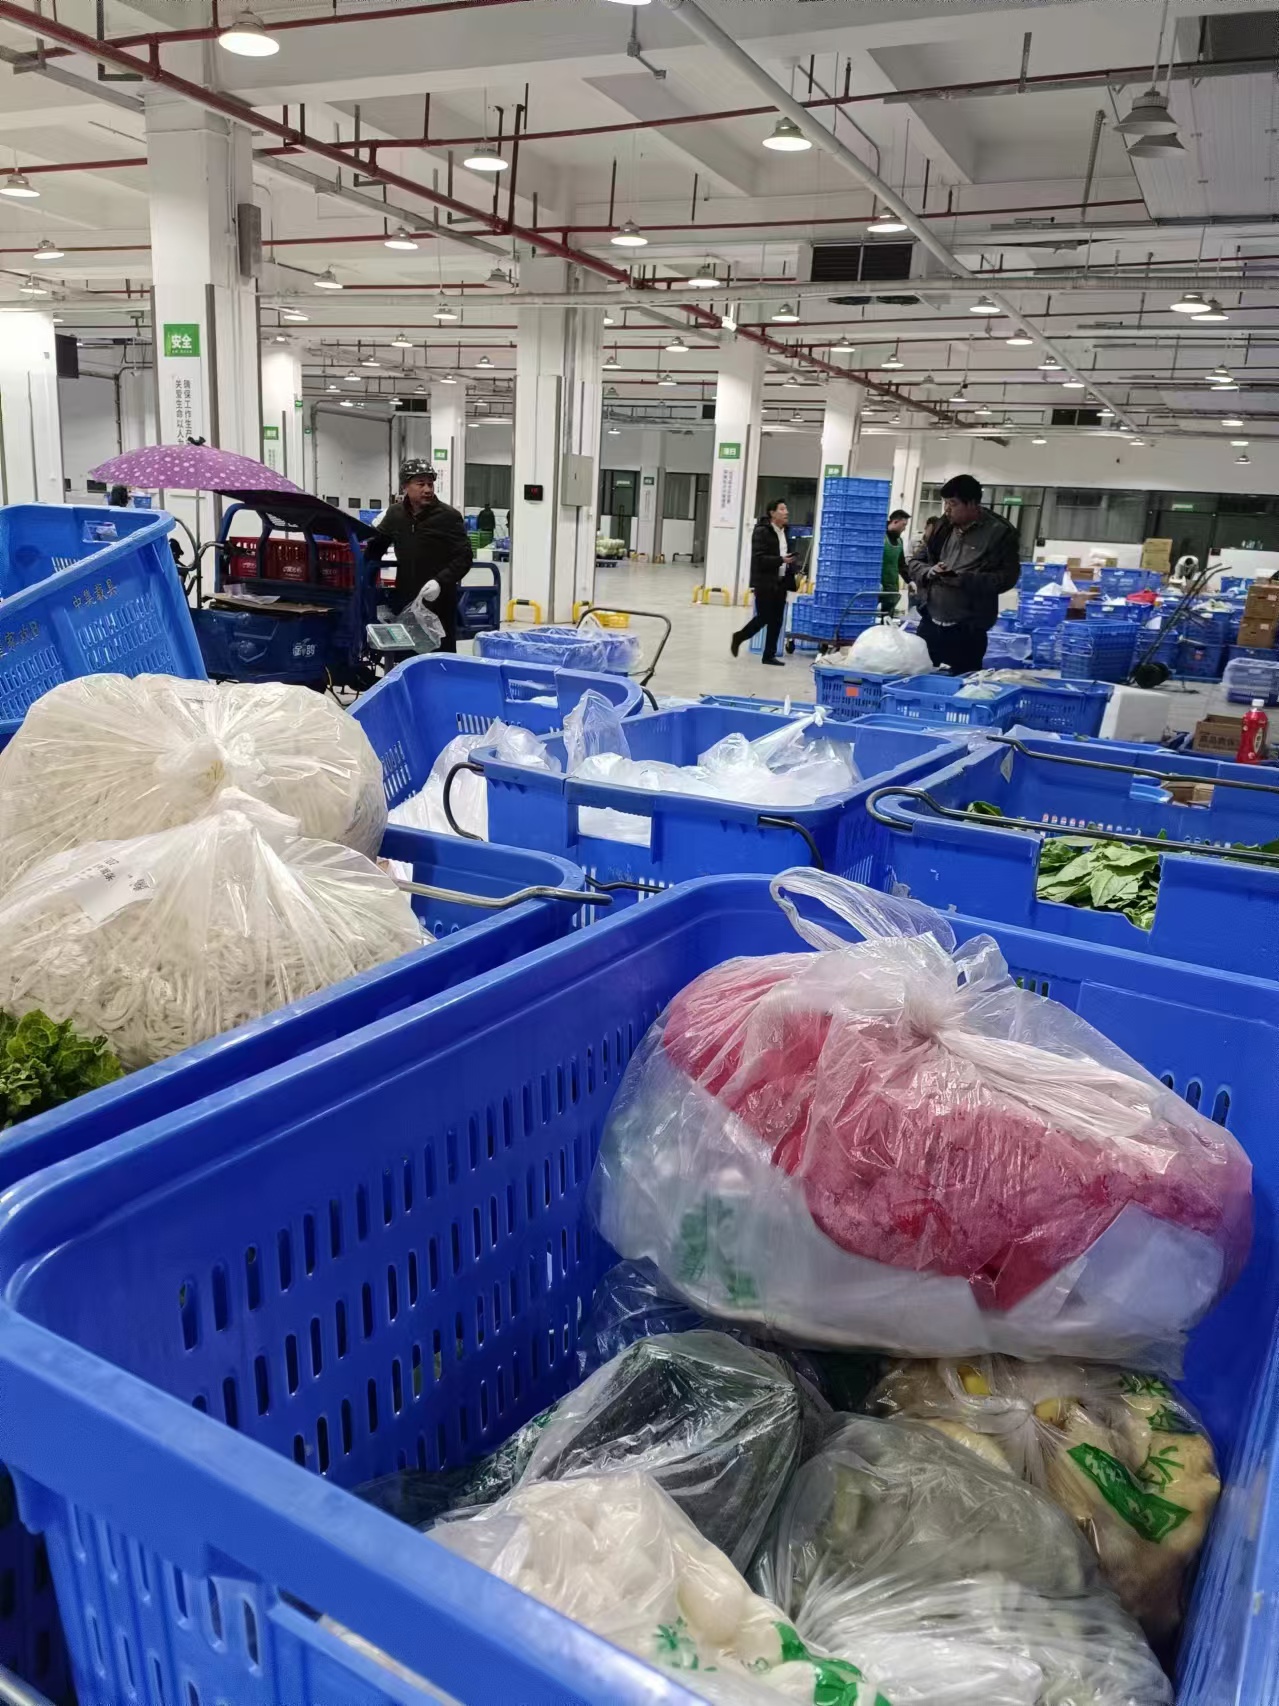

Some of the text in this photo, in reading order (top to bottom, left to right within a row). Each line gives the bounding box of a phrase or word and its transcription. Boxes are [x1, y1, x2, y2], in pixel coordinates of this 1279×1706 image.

[171, 334, 192, 349] 安全
[183, 379, 192, 446] 确保工作生产
